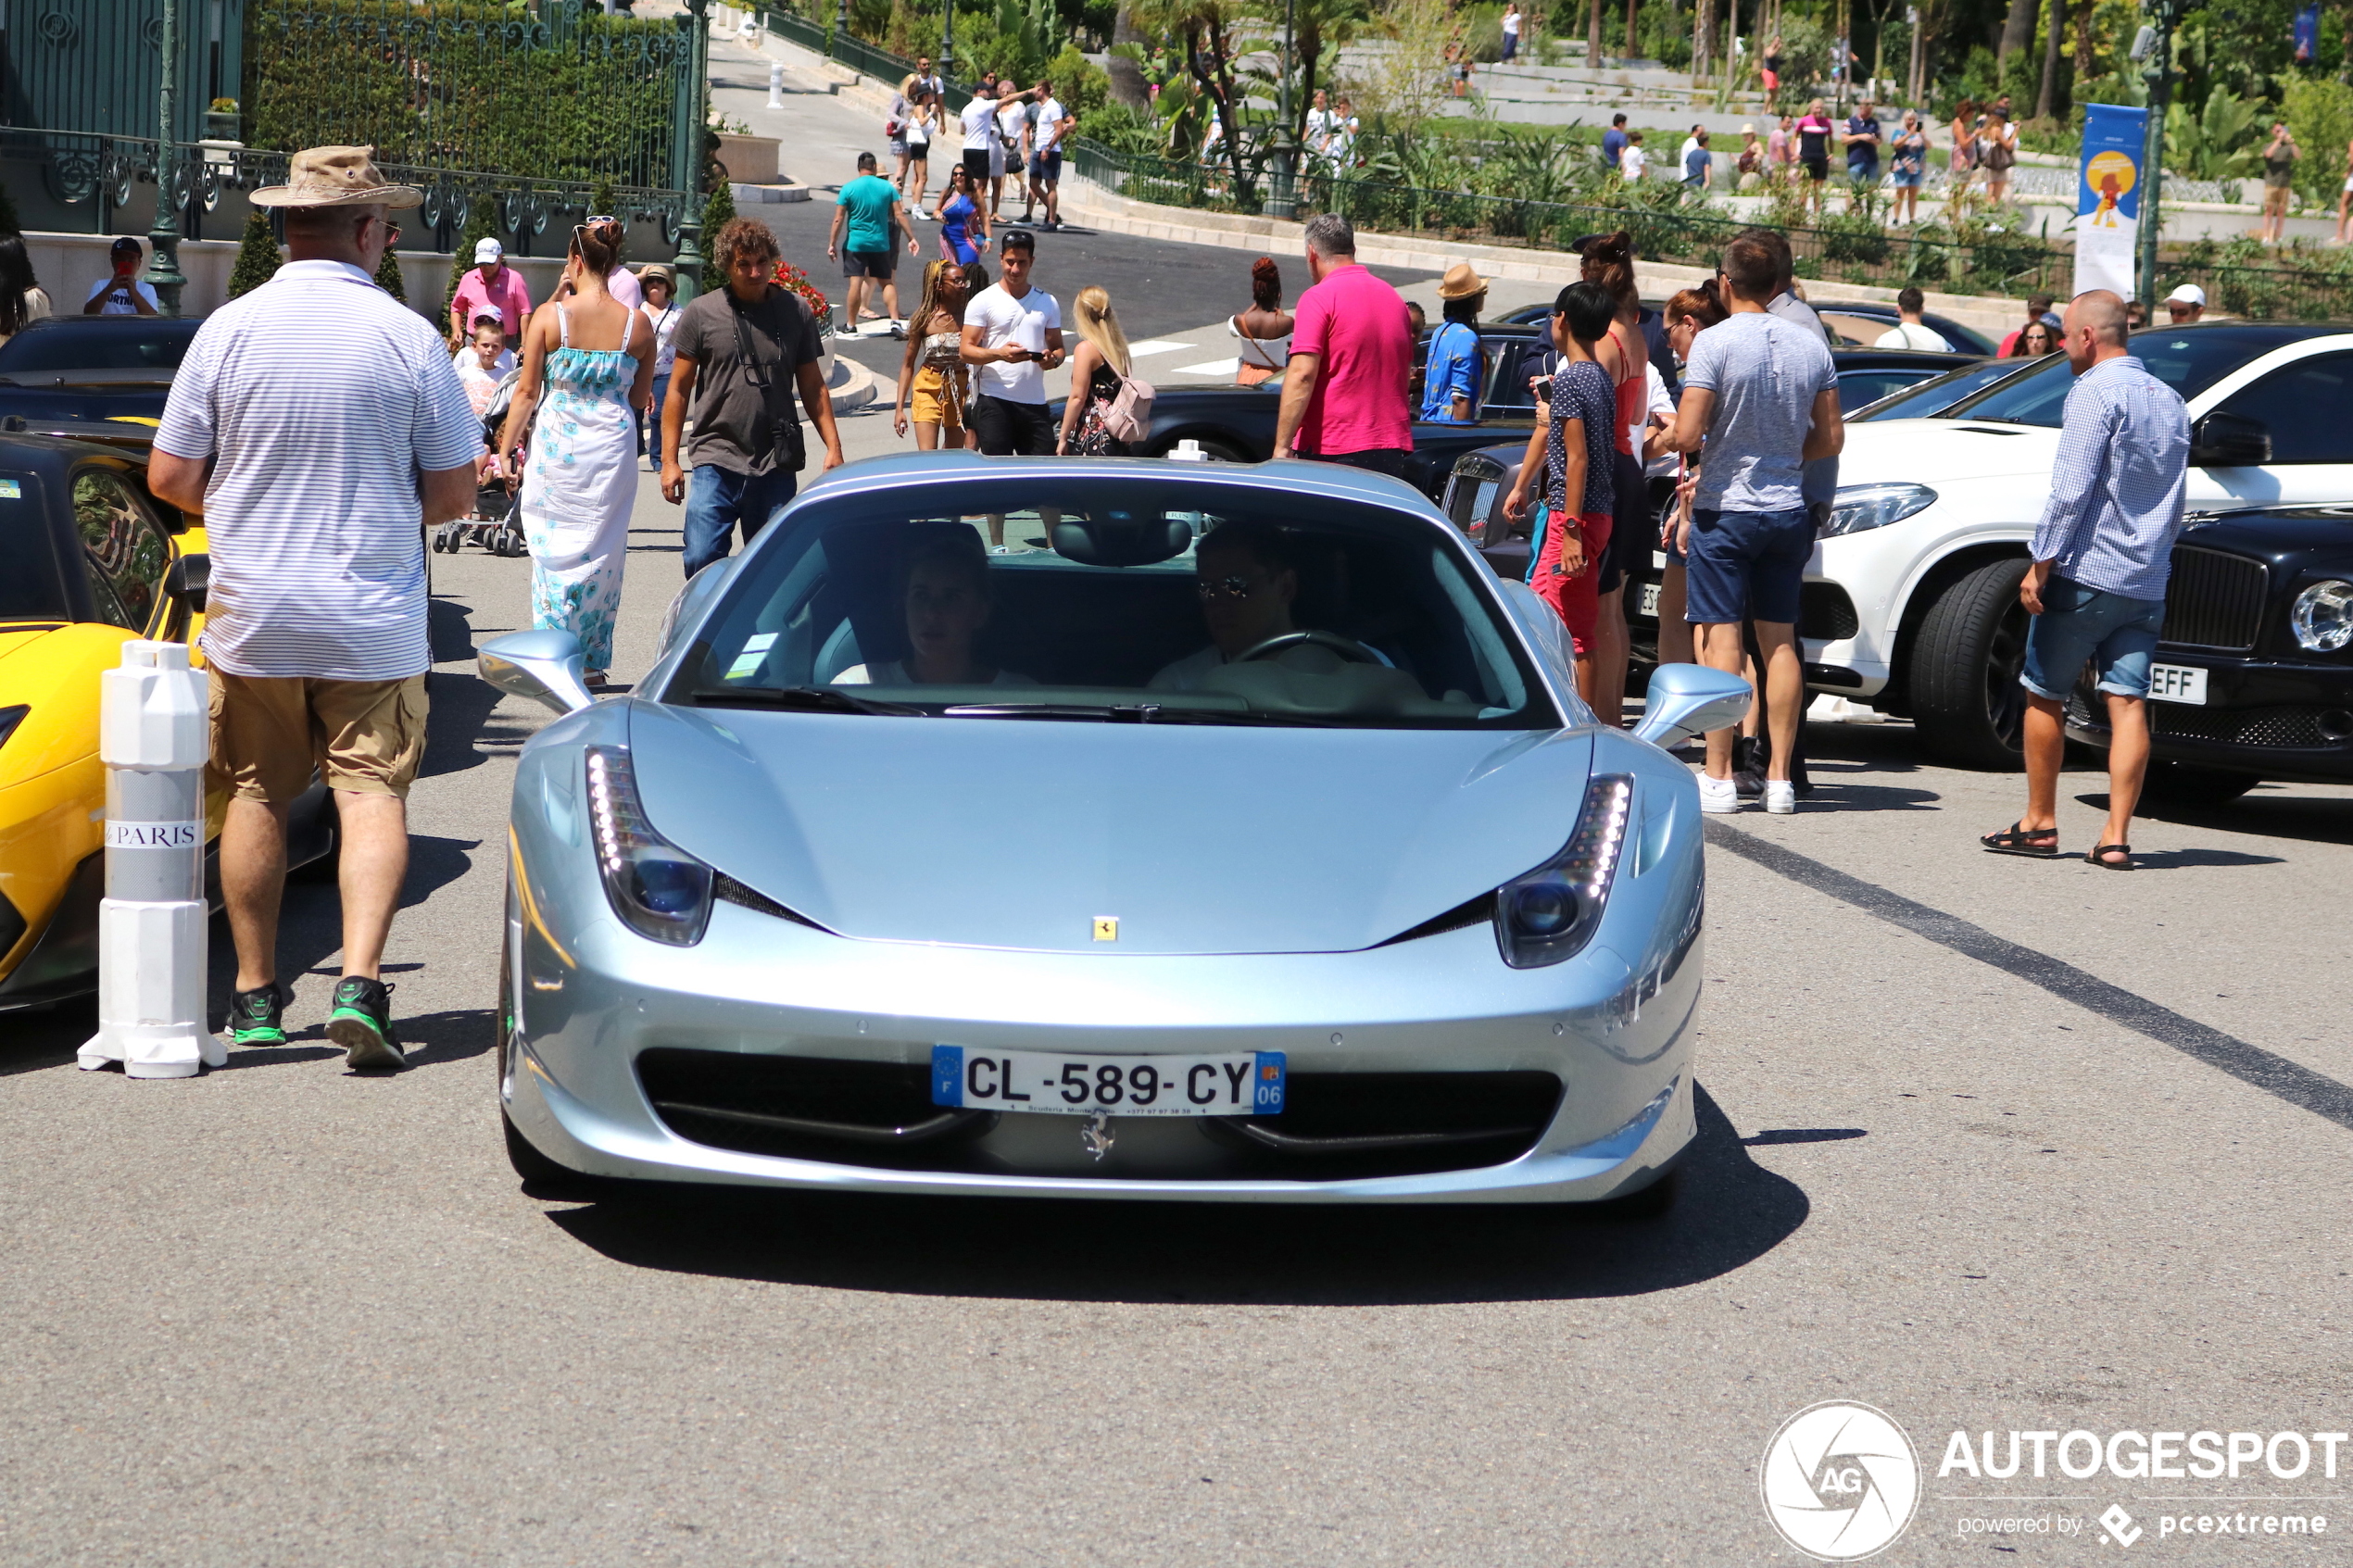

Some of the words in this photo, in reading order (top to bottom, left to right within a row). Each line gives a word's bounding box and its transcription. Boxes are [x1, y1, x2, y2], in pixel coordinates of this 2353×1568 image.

[2152, 668, 2194, 696] EFF
[118, 826, 195, 847] PARIS
[942, 1081, 952, 1093] F
[1257, 1086, 1281, 1105] 06
[1028, 1105, 1063, 1113] Scuderia
